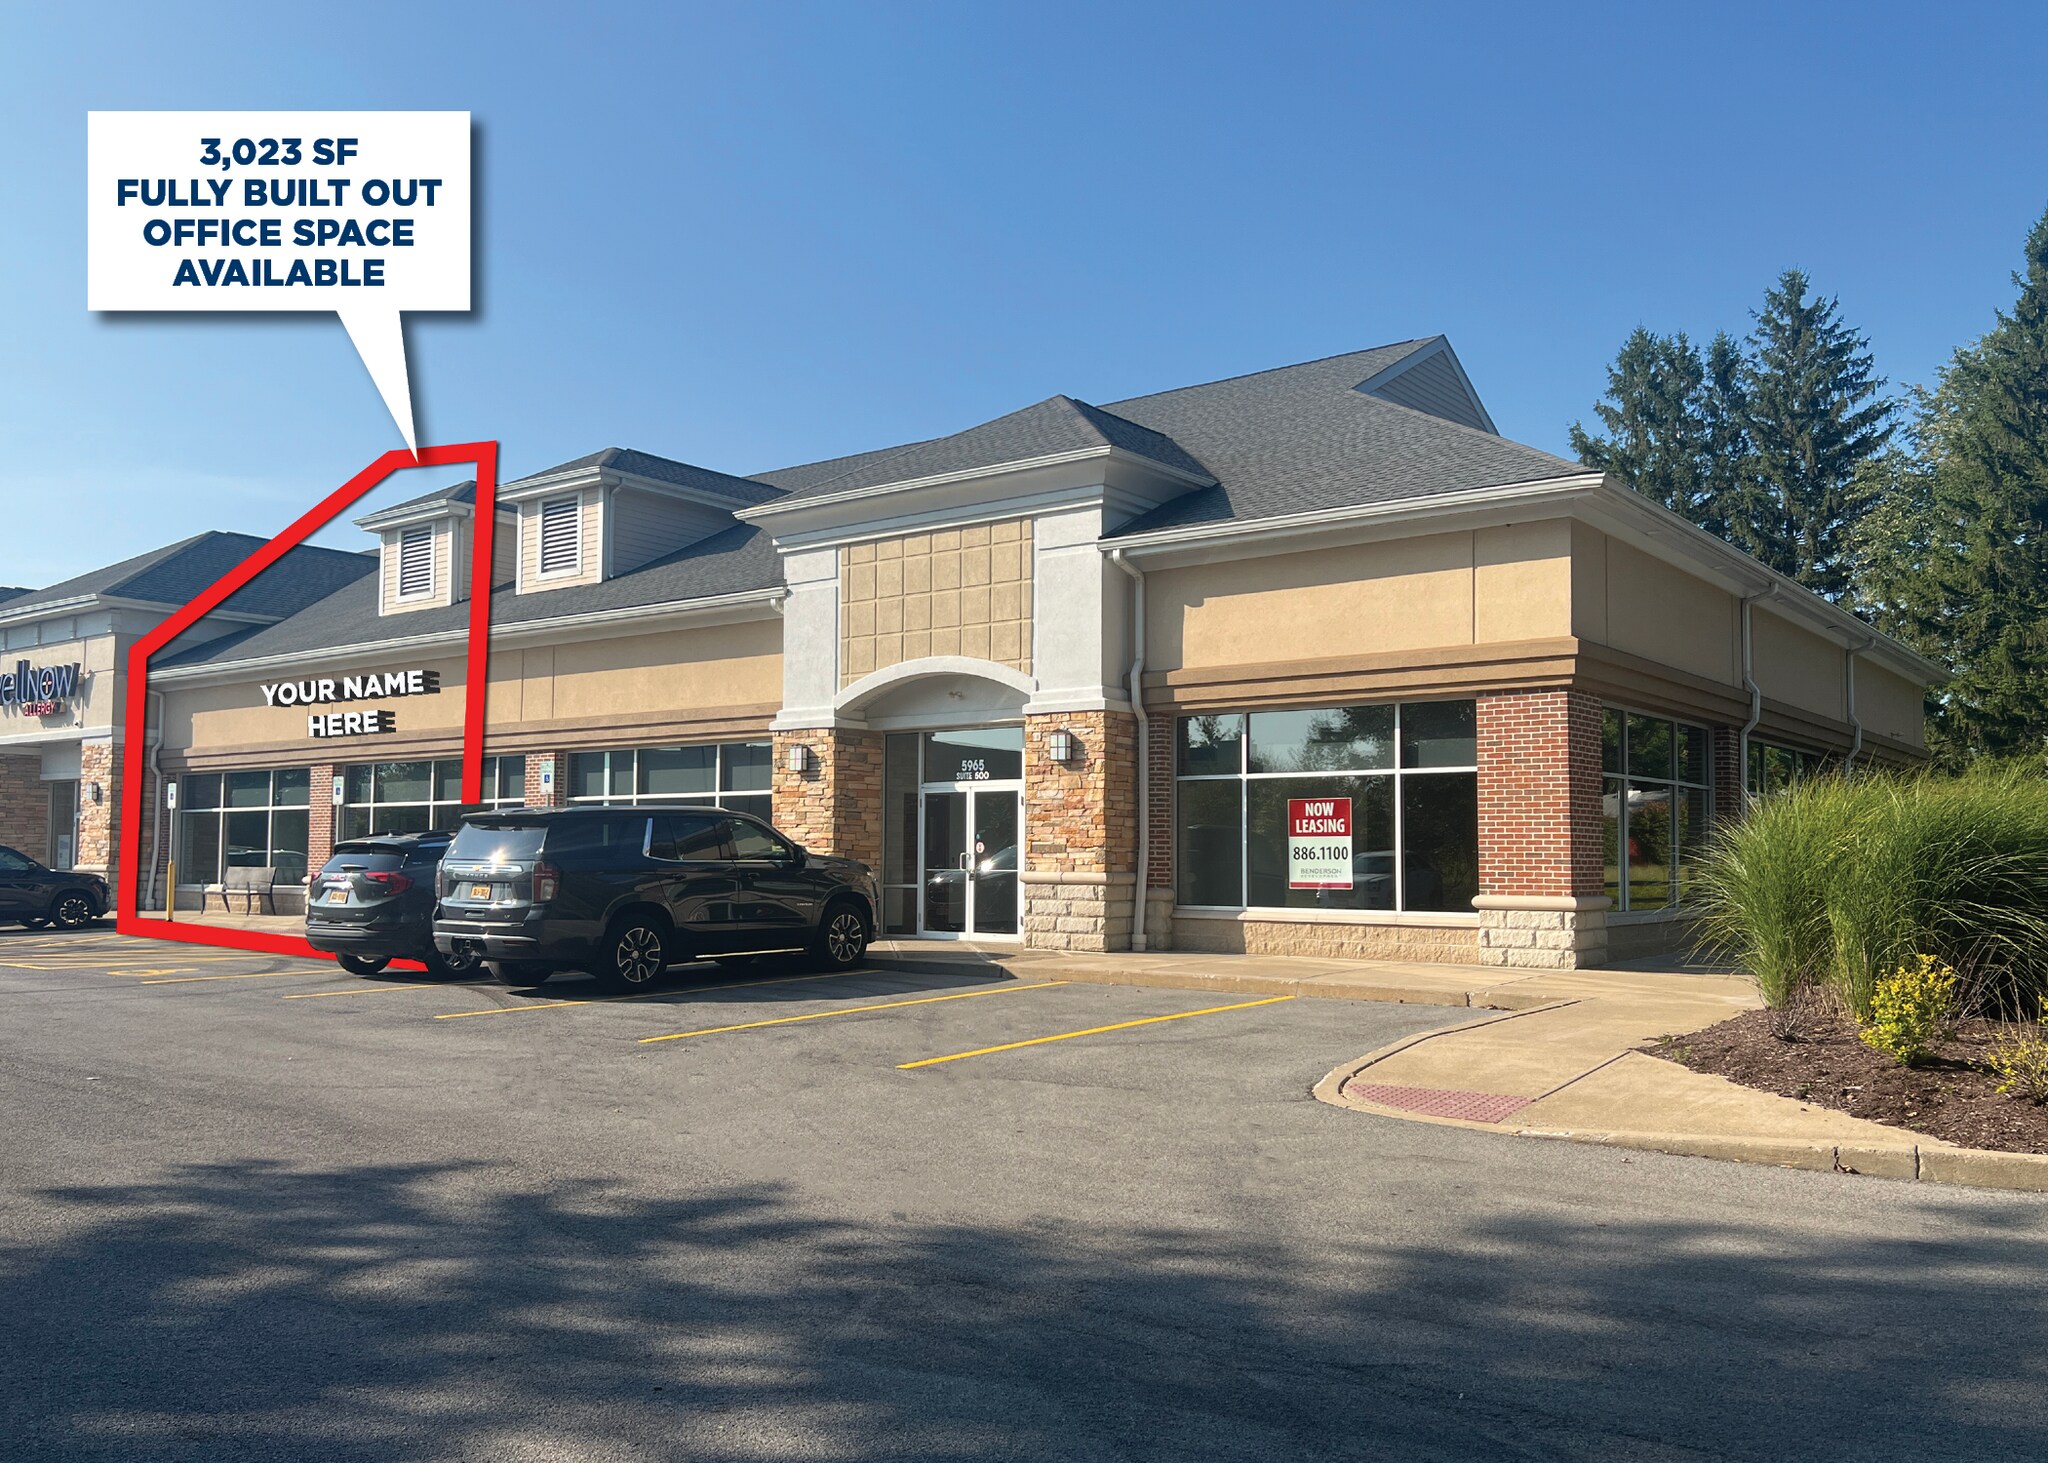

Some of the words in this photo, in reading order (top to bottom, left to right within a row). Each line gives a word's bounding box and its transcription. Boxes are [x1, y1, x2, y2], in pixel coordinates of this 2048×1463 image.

[24, 700, 56, 717] ALLERGY
[961, 759, 985, 772] 5965
[956, 771, 973, 780] SUITE
[1305, 802, 1335, 817] NOW
[1295, 818, 1346, 834] LEASING
[1293, 846, 1349, 861] 886.1100
[1300, 867, 1342, 875] BENDERSON
